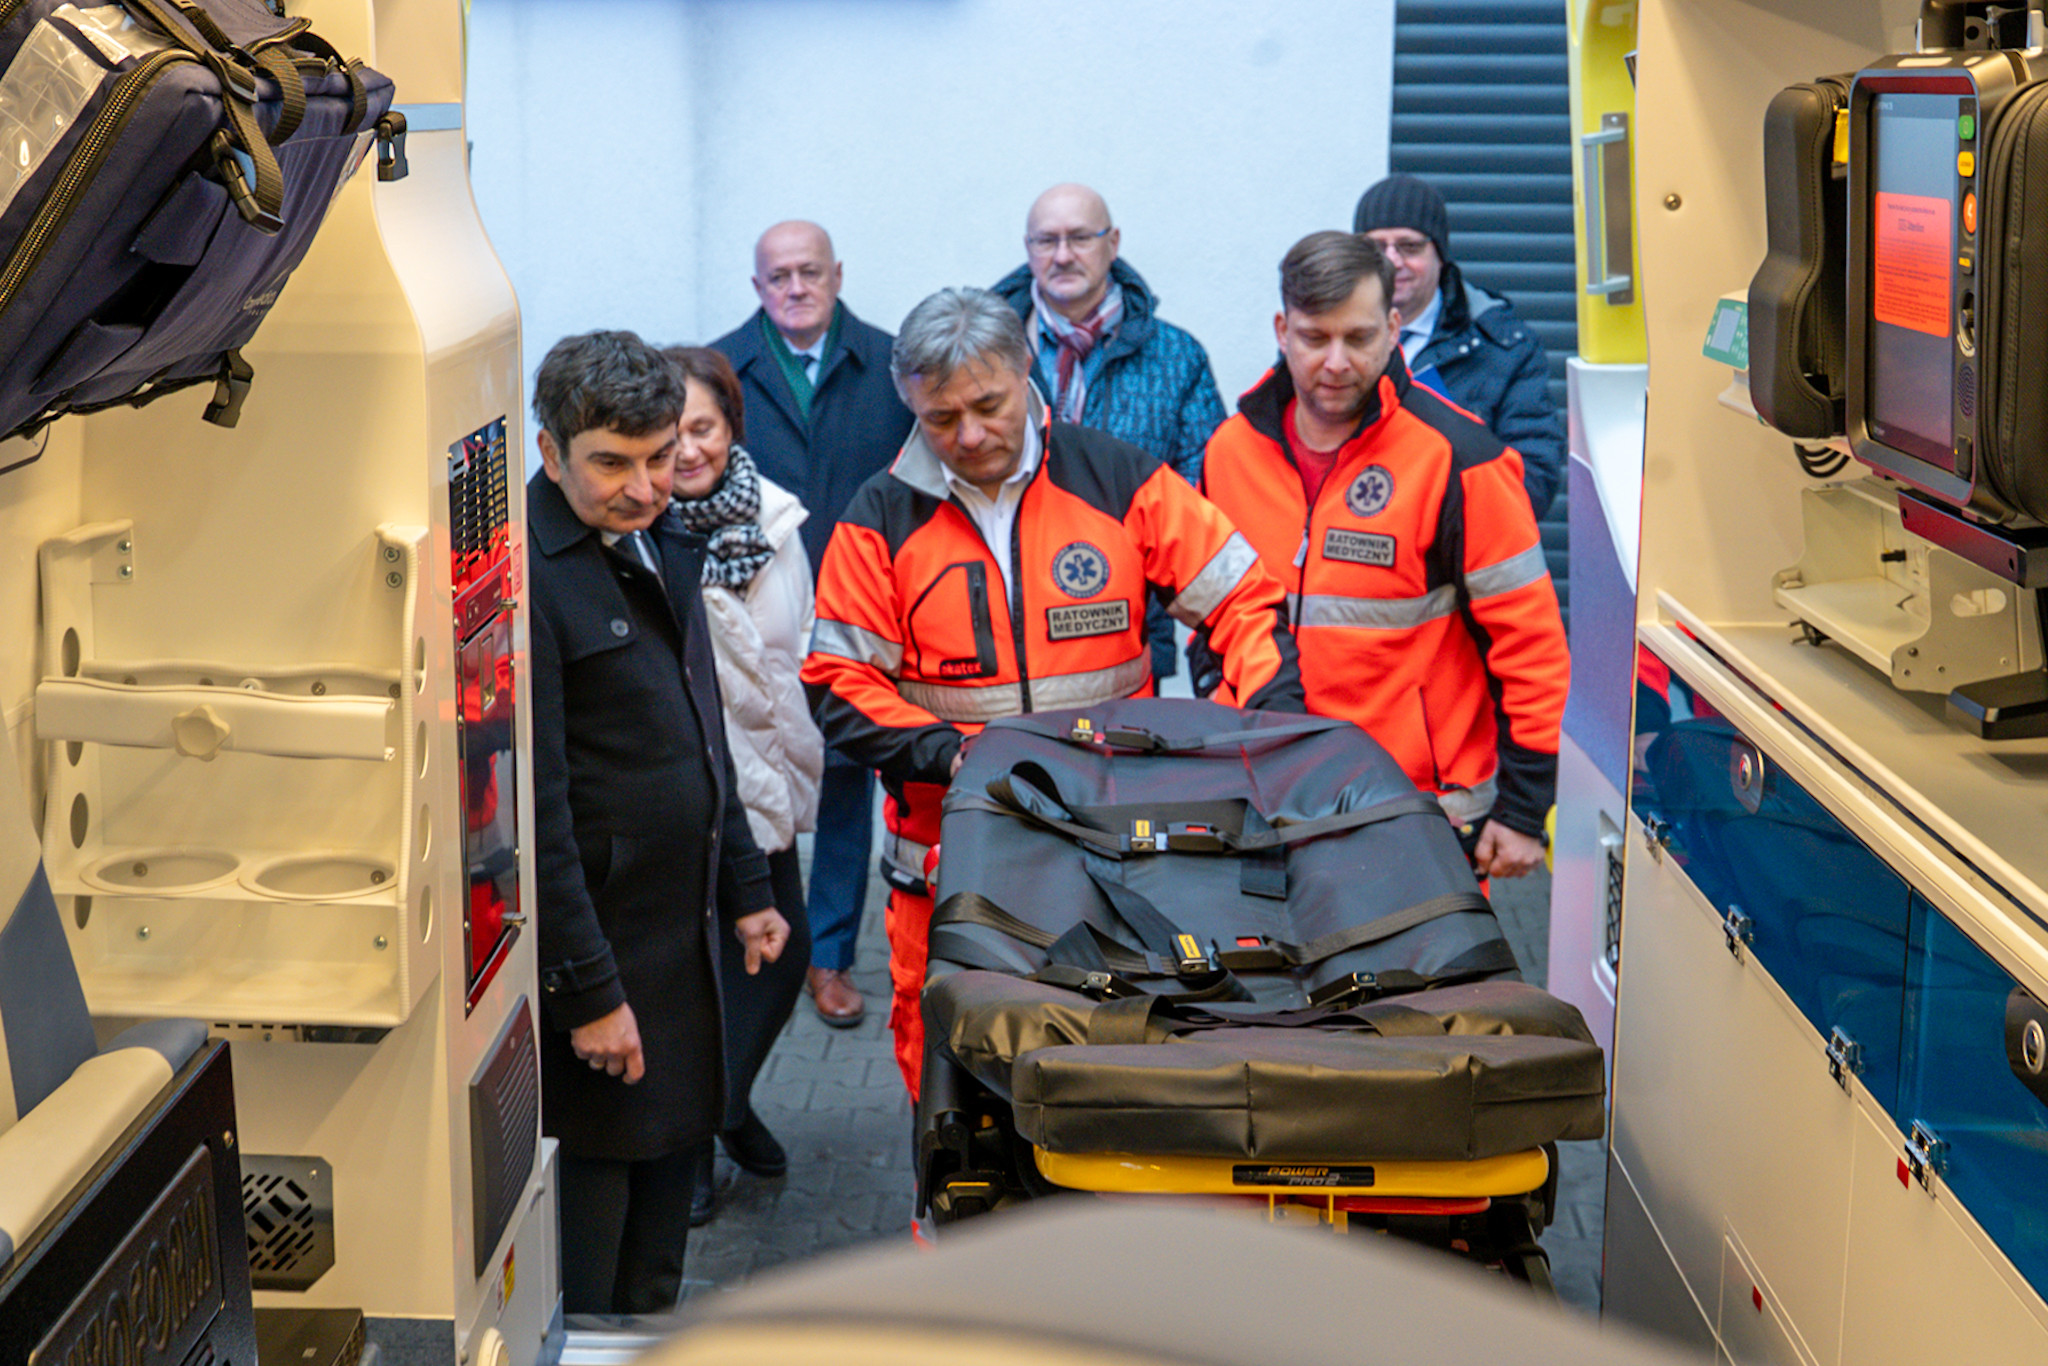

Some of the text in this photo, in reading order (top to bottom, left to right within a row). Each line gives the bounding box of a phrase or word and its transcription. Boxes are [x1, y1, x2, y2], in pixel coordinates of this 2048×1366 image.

[1328, 533, 1390, 550] RATOWNIK
[1326, 544, 1390, 561] MEDYCZNY
[1052, 604, 1123, 621] RATOWNIK
[1053, 617, 1125, 633] MEDYCZNY
[1267, 1167, 1329, 1177] POWER
